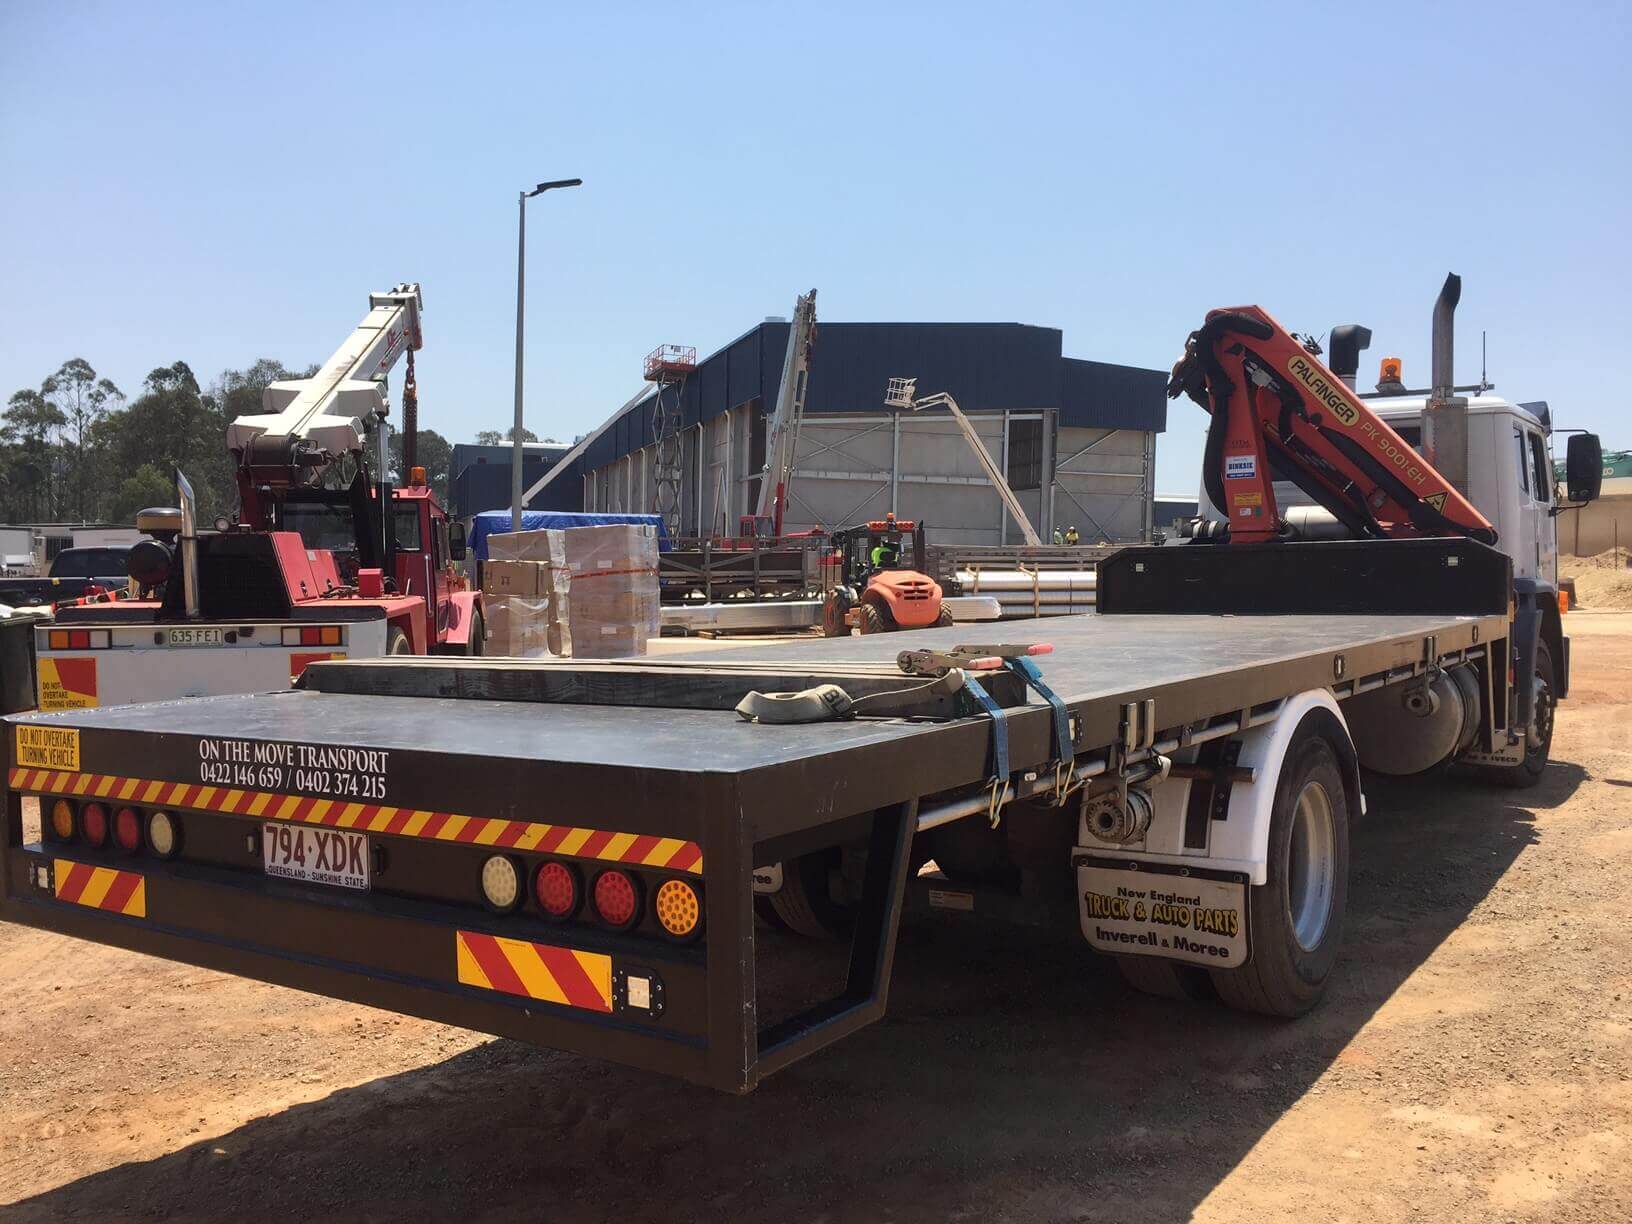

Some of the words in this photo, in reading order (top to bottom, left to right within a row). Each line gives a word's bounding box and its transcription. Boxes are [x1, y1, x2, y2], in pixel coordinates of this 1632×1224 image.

[1291, 360, 1356, 423] PALFINGER
[1360, 422, 1380, 441] PK
[20, 727, 28, 744] DO
[30, 729, 43, 746] NOT
[43, 730, 75, 749] OVERTAKE
[22, 746, 48, 764] TURNING
[48, 748, 75, 767] VEHICLE
[199, 739, 220, 760] ON
[223, 740, 250, 762] THE
[254, 743, 294, 766] MOVE
[297, 745, 390, 774] TRANSPORT
[200, 761, 231, 783] 0422
[234, 764, 255, 786] 146
[258, 766, 282, 788] 659
[296, 769, 330, 794] 0402
[334, 772, 359, 796] 374
[362, 775, 386, 799] 215
[268, 864, 306, 879] QUEENSLAND
[311, 871, 342, 885] SUNSHINE
[344, 876, 364, 888] STATE
[1117, 887, 1147, 899] New
[1150, 890, 1201, 906] England
[1085, 891, 1130, 920] TRUCK
[1134, 901, 1147, 921] &
[1151, 903, 1191, 928] AUTO
[1194, 908, 1239, 938] PARTS
[1096, 926, 1158, 946] Inverell
[1161, 938, 1170, 948] &
[1173, 935, 1230, 958] Moree
